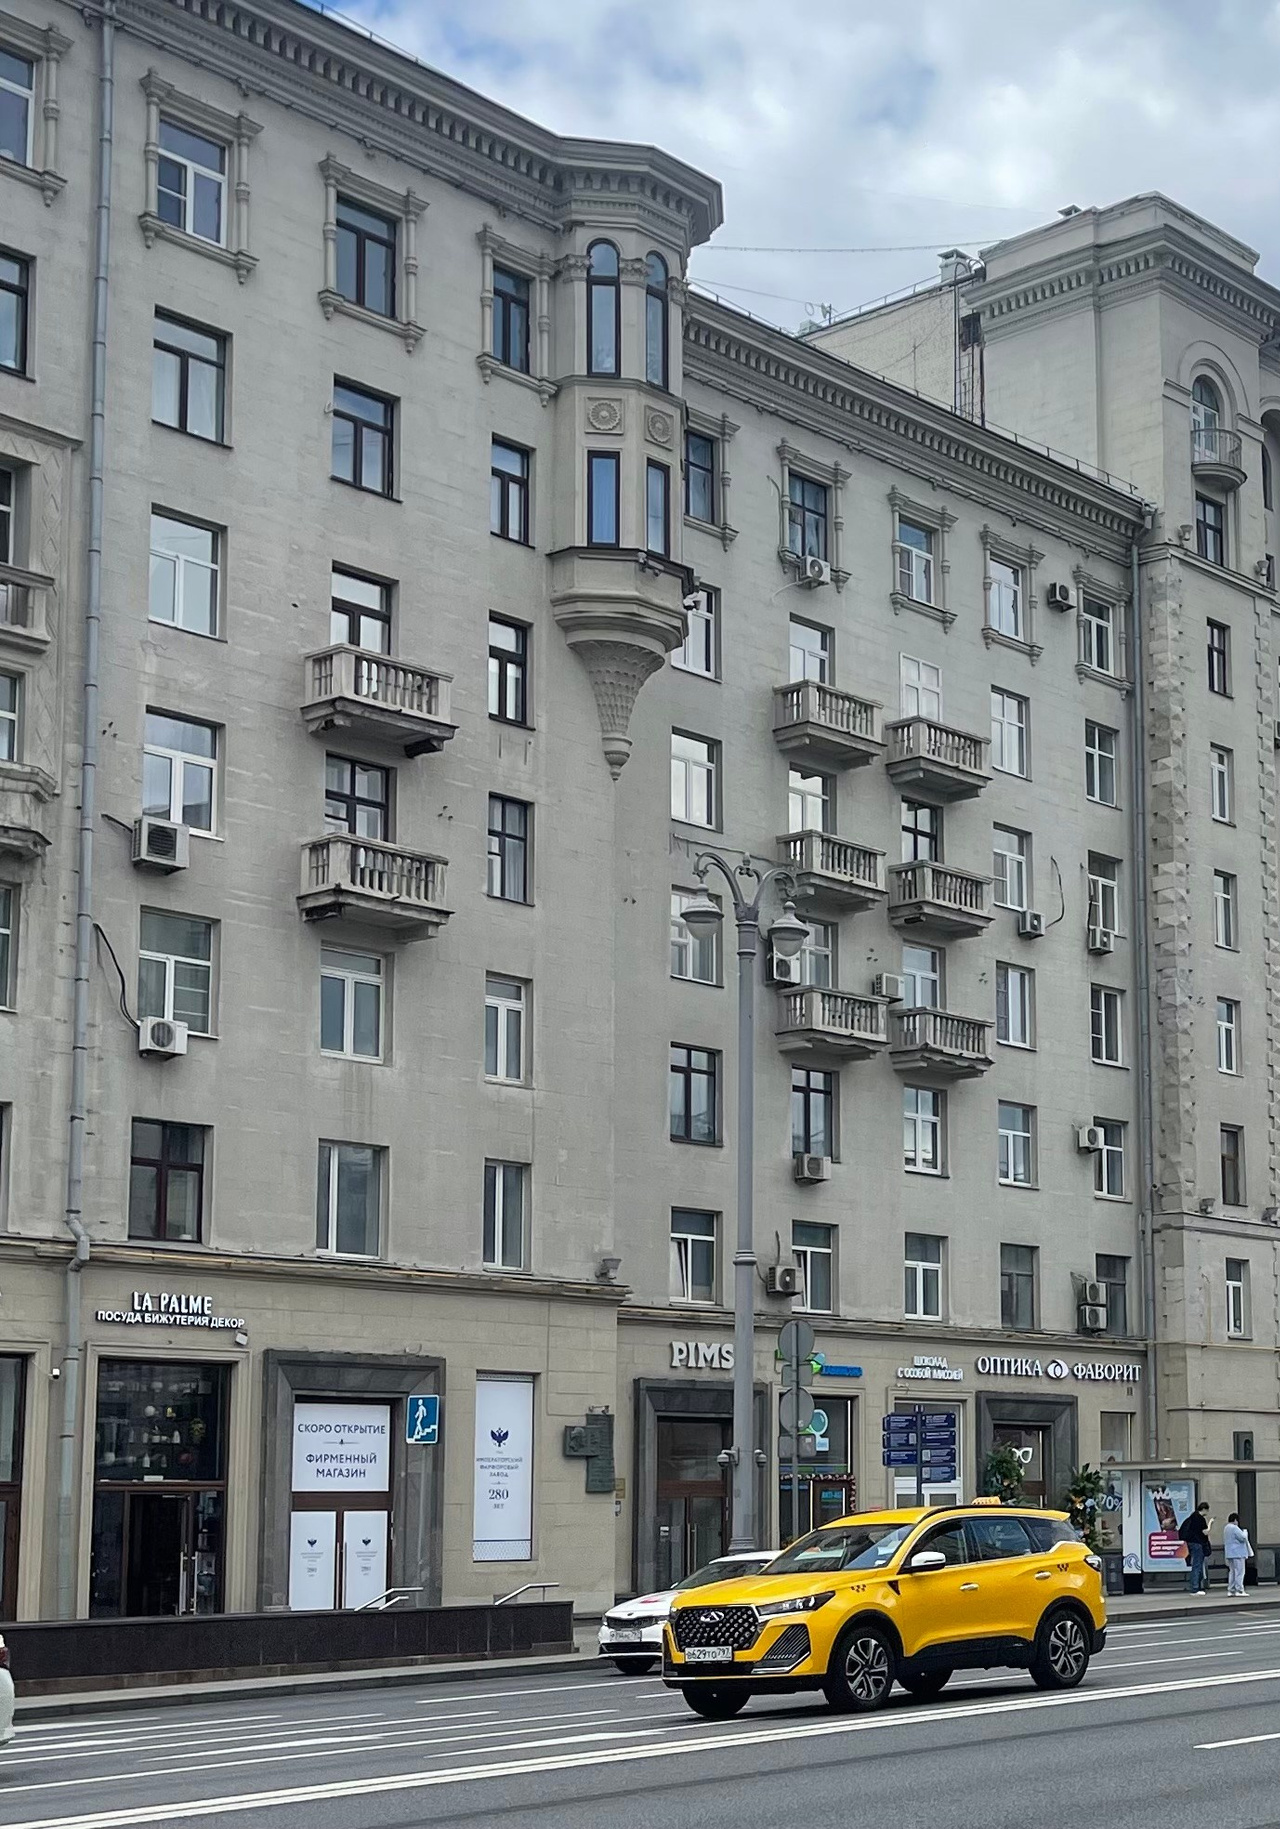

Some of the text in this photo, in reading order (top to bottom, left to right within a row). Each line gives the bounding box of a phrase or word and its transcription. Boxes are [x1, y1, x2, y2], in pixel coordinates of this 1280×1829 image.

[133, 1291, 213, 1315] LA PALME
[97, 1310, 245, 1328] ПОСУДА БИЖУТЕРИЯ ДЕКОР
[671, 1341, 734, 1369] PIMS
[898, 1367, 904, 1378] С
[904, 1367, 932, 1379] ОСОБОЙ
[977, 1356, 1142, 1381] ОПТИКА ФАВОРИТ
[297, 1423, 386, 1435] СКОРО ОТКРЫТИЕ
[305, 1452, 377, 1464] ФИРМЕННЫЙ
[316, 1468, 366, 1479] МАГАЗИН
[488, 1488, 509, 1500] 280
